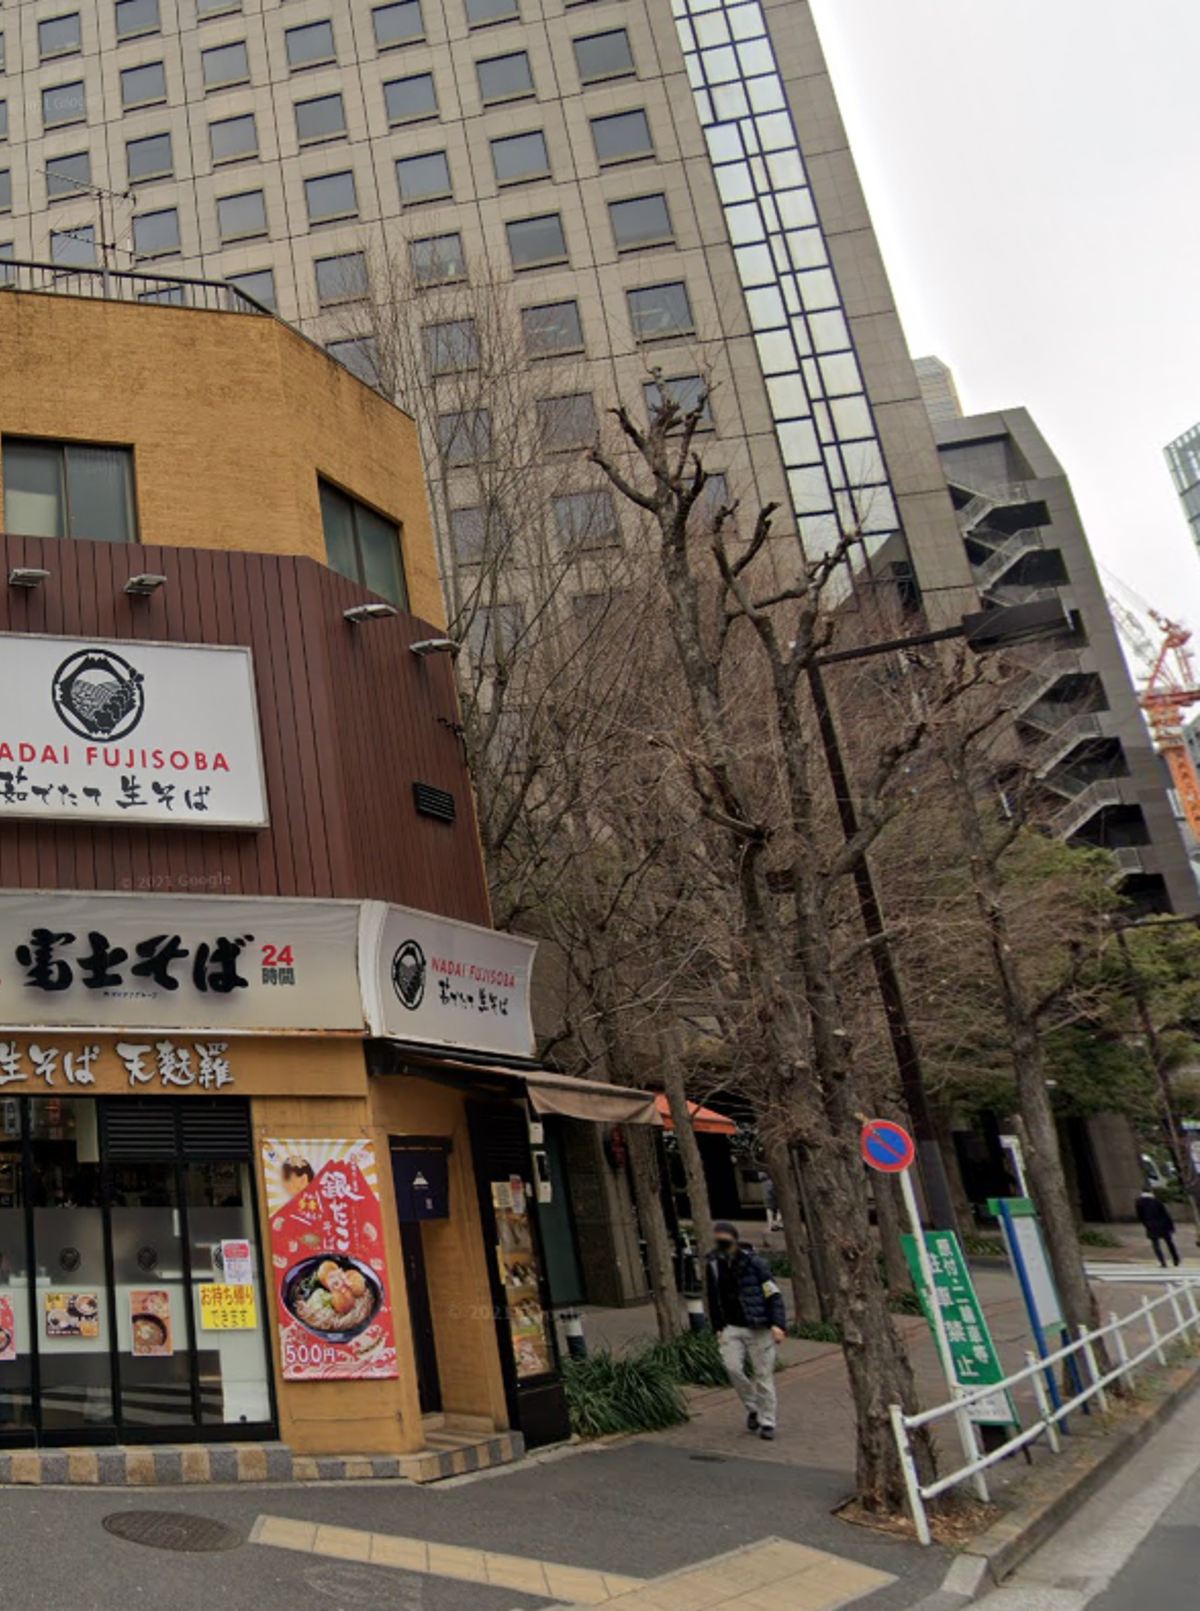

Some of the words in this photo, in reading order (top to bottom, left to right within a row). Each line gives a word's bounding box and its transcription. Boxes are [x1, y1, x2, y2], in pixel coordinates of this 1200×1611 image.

[86, 746, 230, 772] FUJISOBA
[116, 775, 211, 811] 生そば
[261, 945, 294, 966] 24
[261, 967, 295, 985] 時間
[431, 956, 465, 977] NADAI
[470, 965, 515, 988] FUJISOBA
[285, 1344, 336, 1364] 500円
